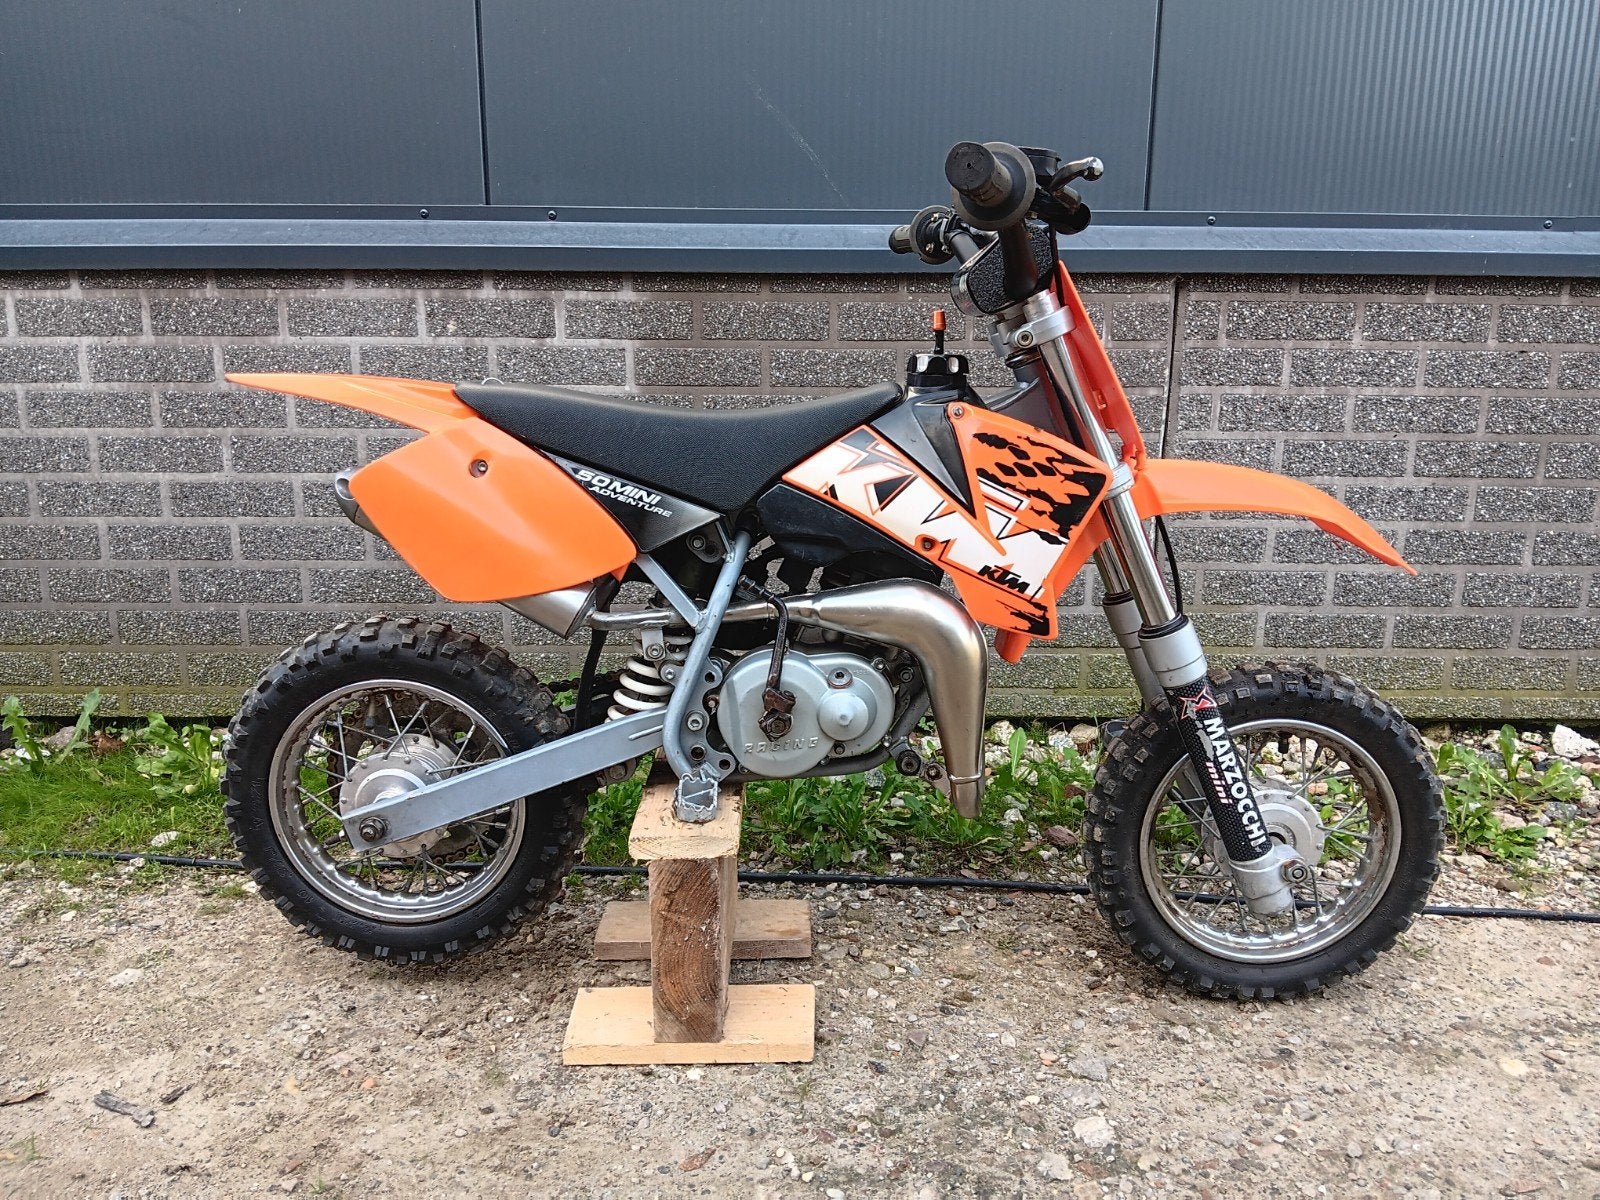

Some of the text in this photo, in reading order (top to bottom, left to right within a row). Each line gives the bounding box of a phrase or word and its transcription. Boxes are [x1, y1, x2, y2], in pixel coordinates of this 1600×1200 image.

[588, 486, 673, 518] ADVENTURE
[978, 565, 1030, 594] KTM
[744, 736, 819, 754] RACING
[1203, 717, 1267, 848] MARZOCCHI
[1206, 762, 1233, 804] mini
